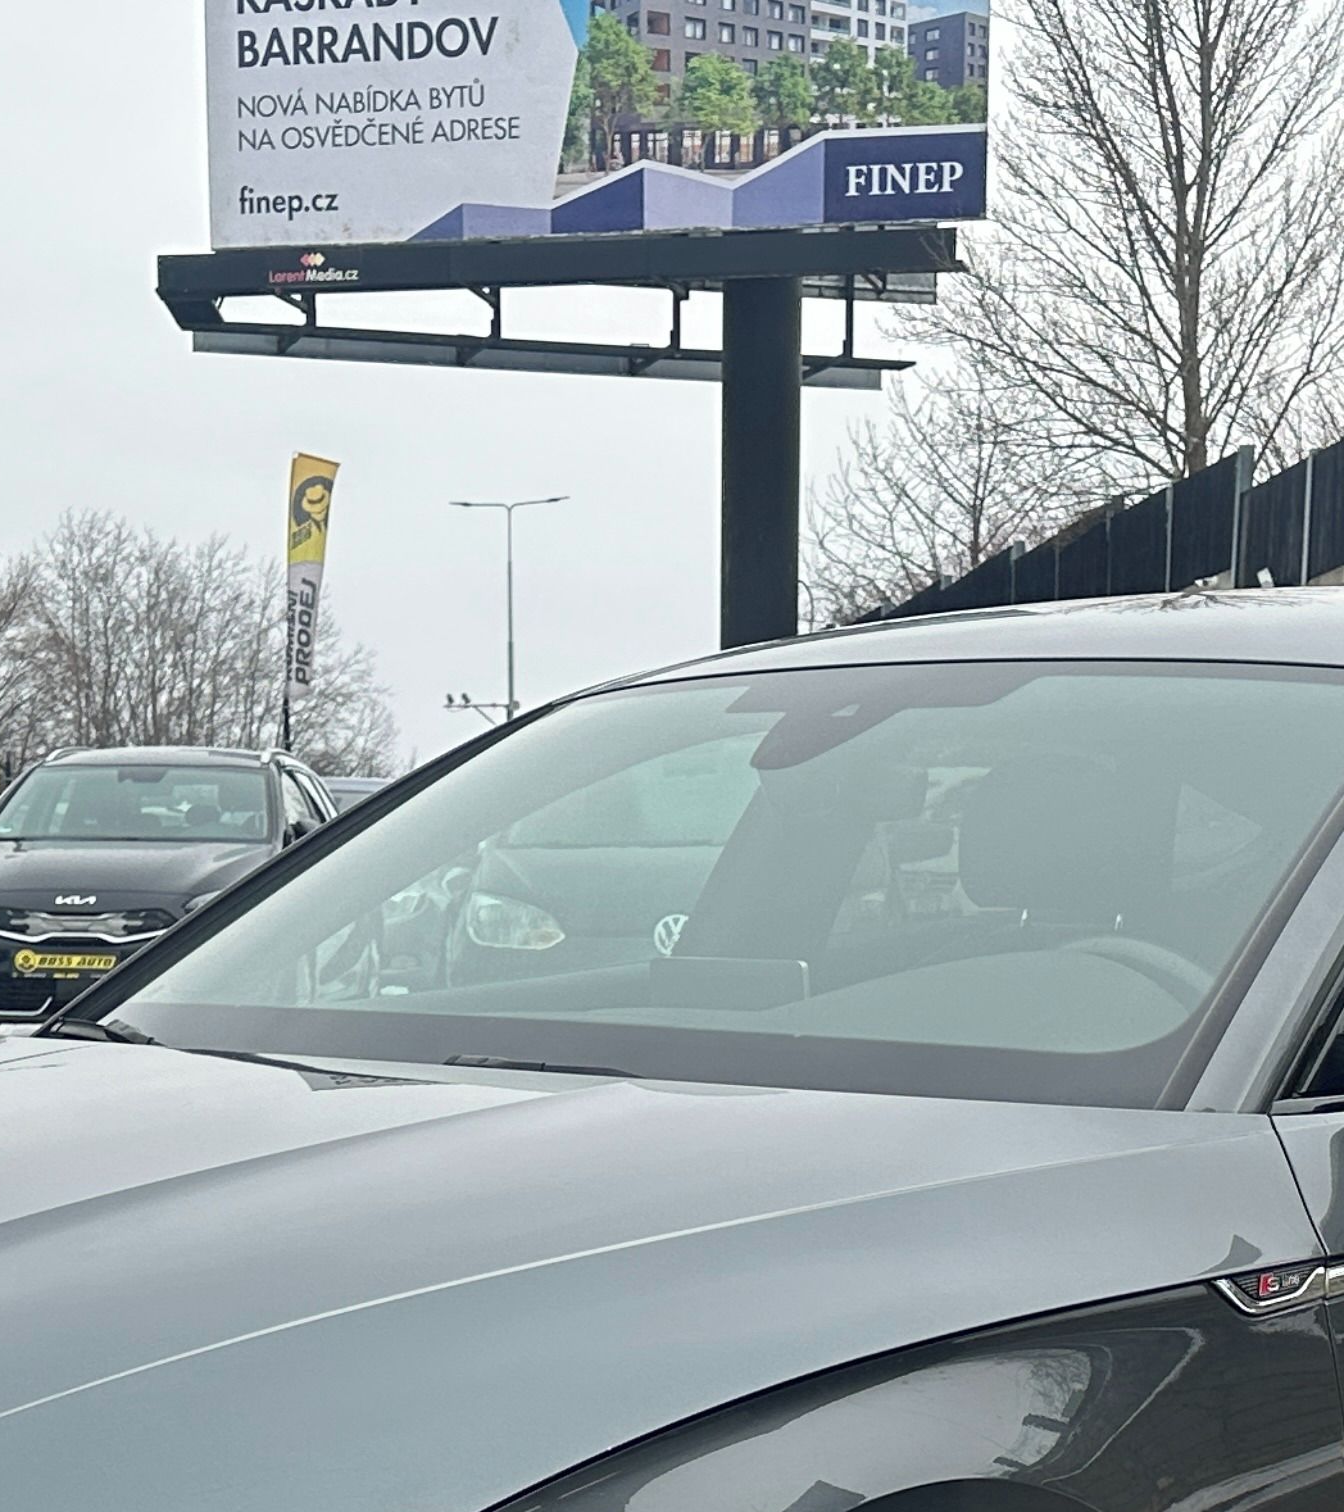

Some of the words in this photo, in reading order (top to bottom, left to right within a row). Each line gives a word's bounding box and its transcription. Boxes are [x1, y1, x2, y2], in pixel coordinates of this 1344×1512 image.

[237, 16, 499, 68] BARRANDOV
[238, 87, 309, 118] NOVÁ
[315, 84, 422, 115] NABÍDKA
[429, 78, 485, 110] BYTŮ
[238, 129, 276, 151] NA
[281, 116, 424, 149] OSVĚDČENÉ
[431, 116, 521, 143] ADRESE
[844, 161, 964, 197] FINEP
[239, 185, 339, 222] finep.cz
[295, 577, 317, 687] PRODEJ
